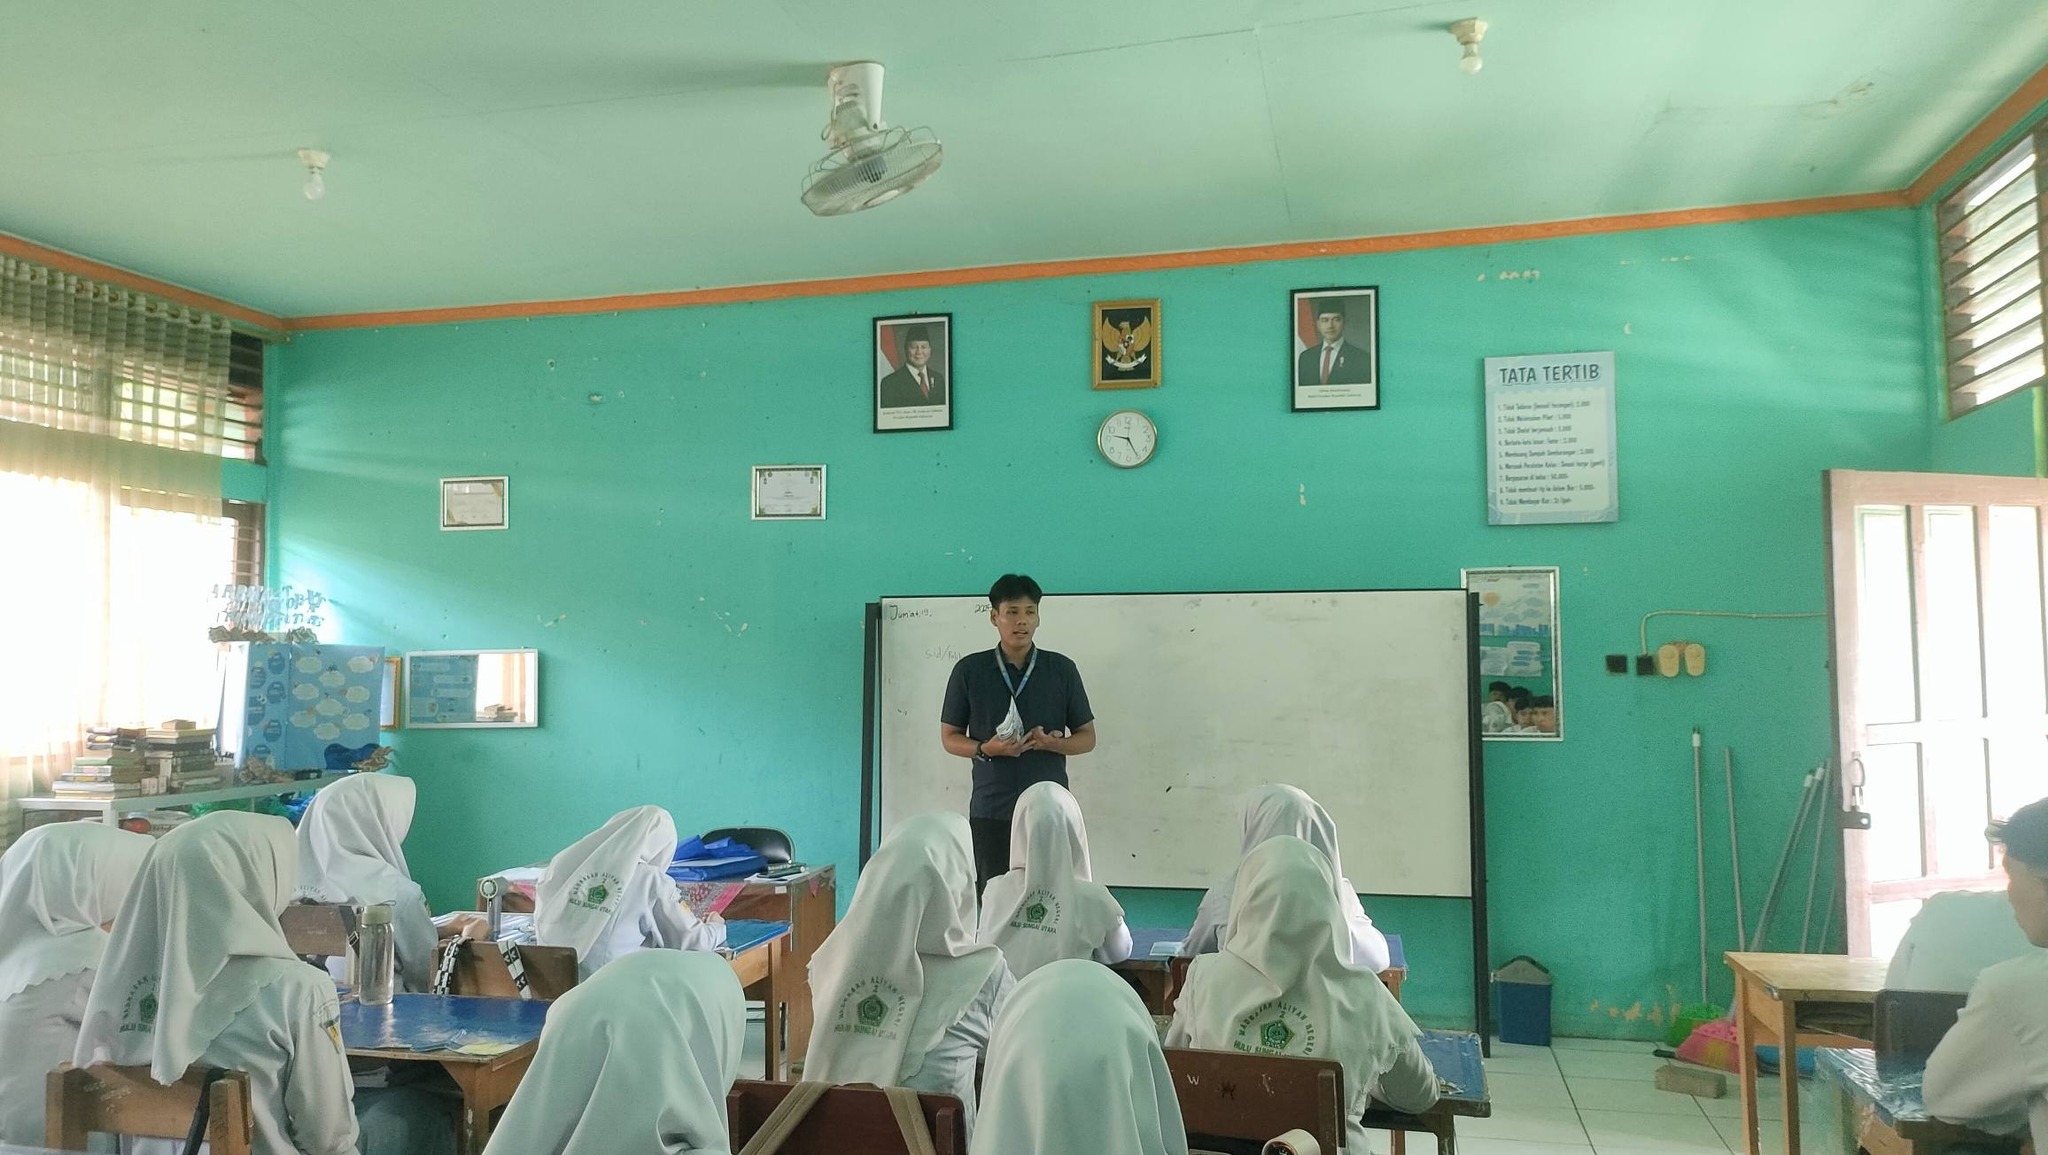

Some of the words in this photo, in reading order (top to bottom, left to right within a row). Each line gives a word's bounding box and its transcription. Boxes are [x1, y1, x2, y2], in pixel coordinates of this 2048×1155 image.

[1499, 367, 1537, 383] TATA
[1542, 364, 1600, 381] TERTIB
[1041, 925, 1057, 934] UTARA
[1278, 1001, 1308, 1021] ALIYAH
[1303, 1023, 1315, 1056] NEGERI
